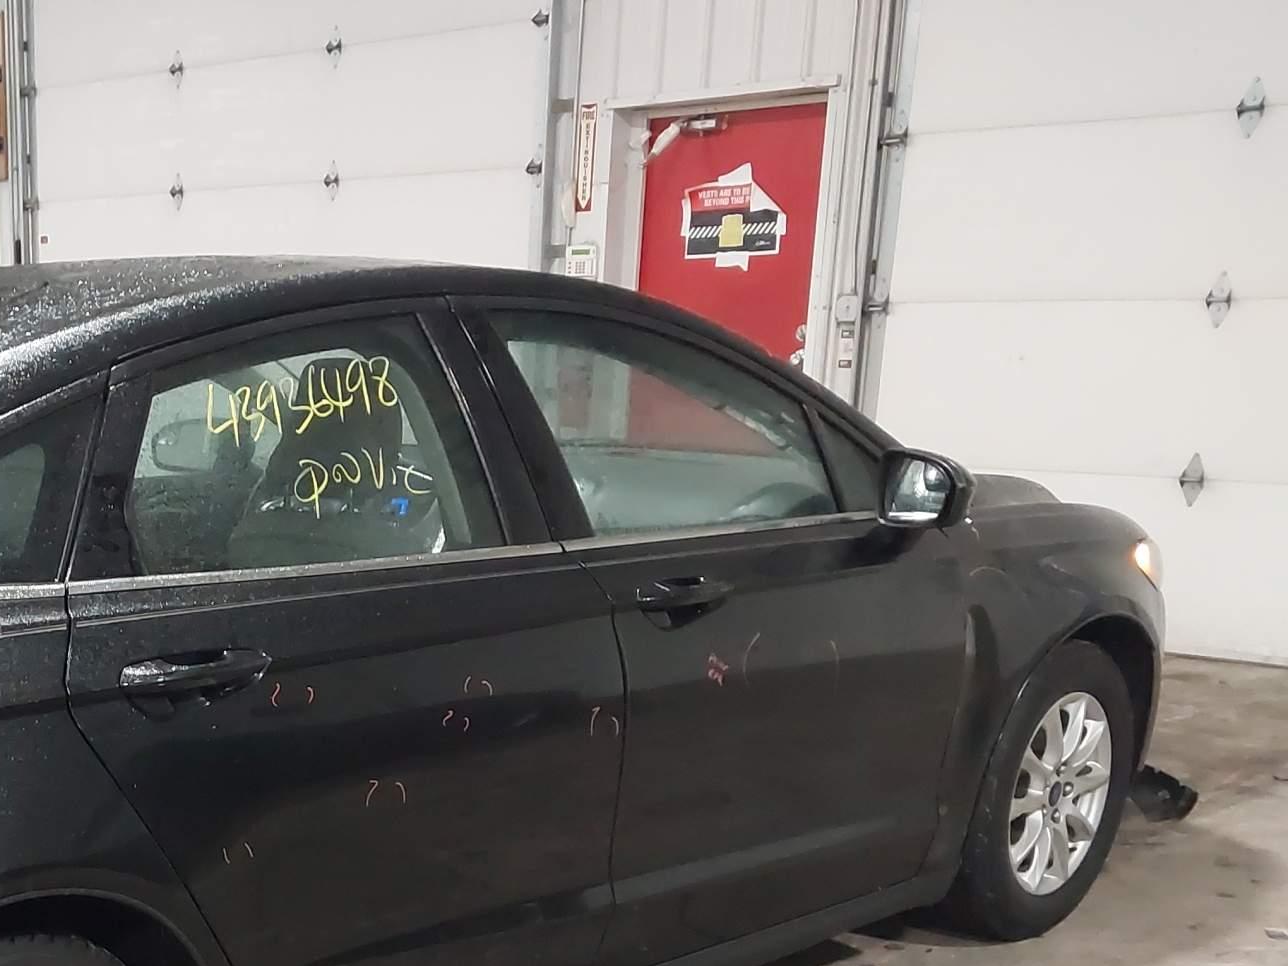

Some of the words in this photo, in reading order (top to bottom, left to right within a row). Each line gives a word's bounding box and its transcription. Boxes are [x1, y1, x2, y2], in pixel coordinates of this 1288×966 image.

[582, 111, 595, 120] FIRE
[733, 187, 741, 196] TO
[207, 356, 399, 448] 43936498
